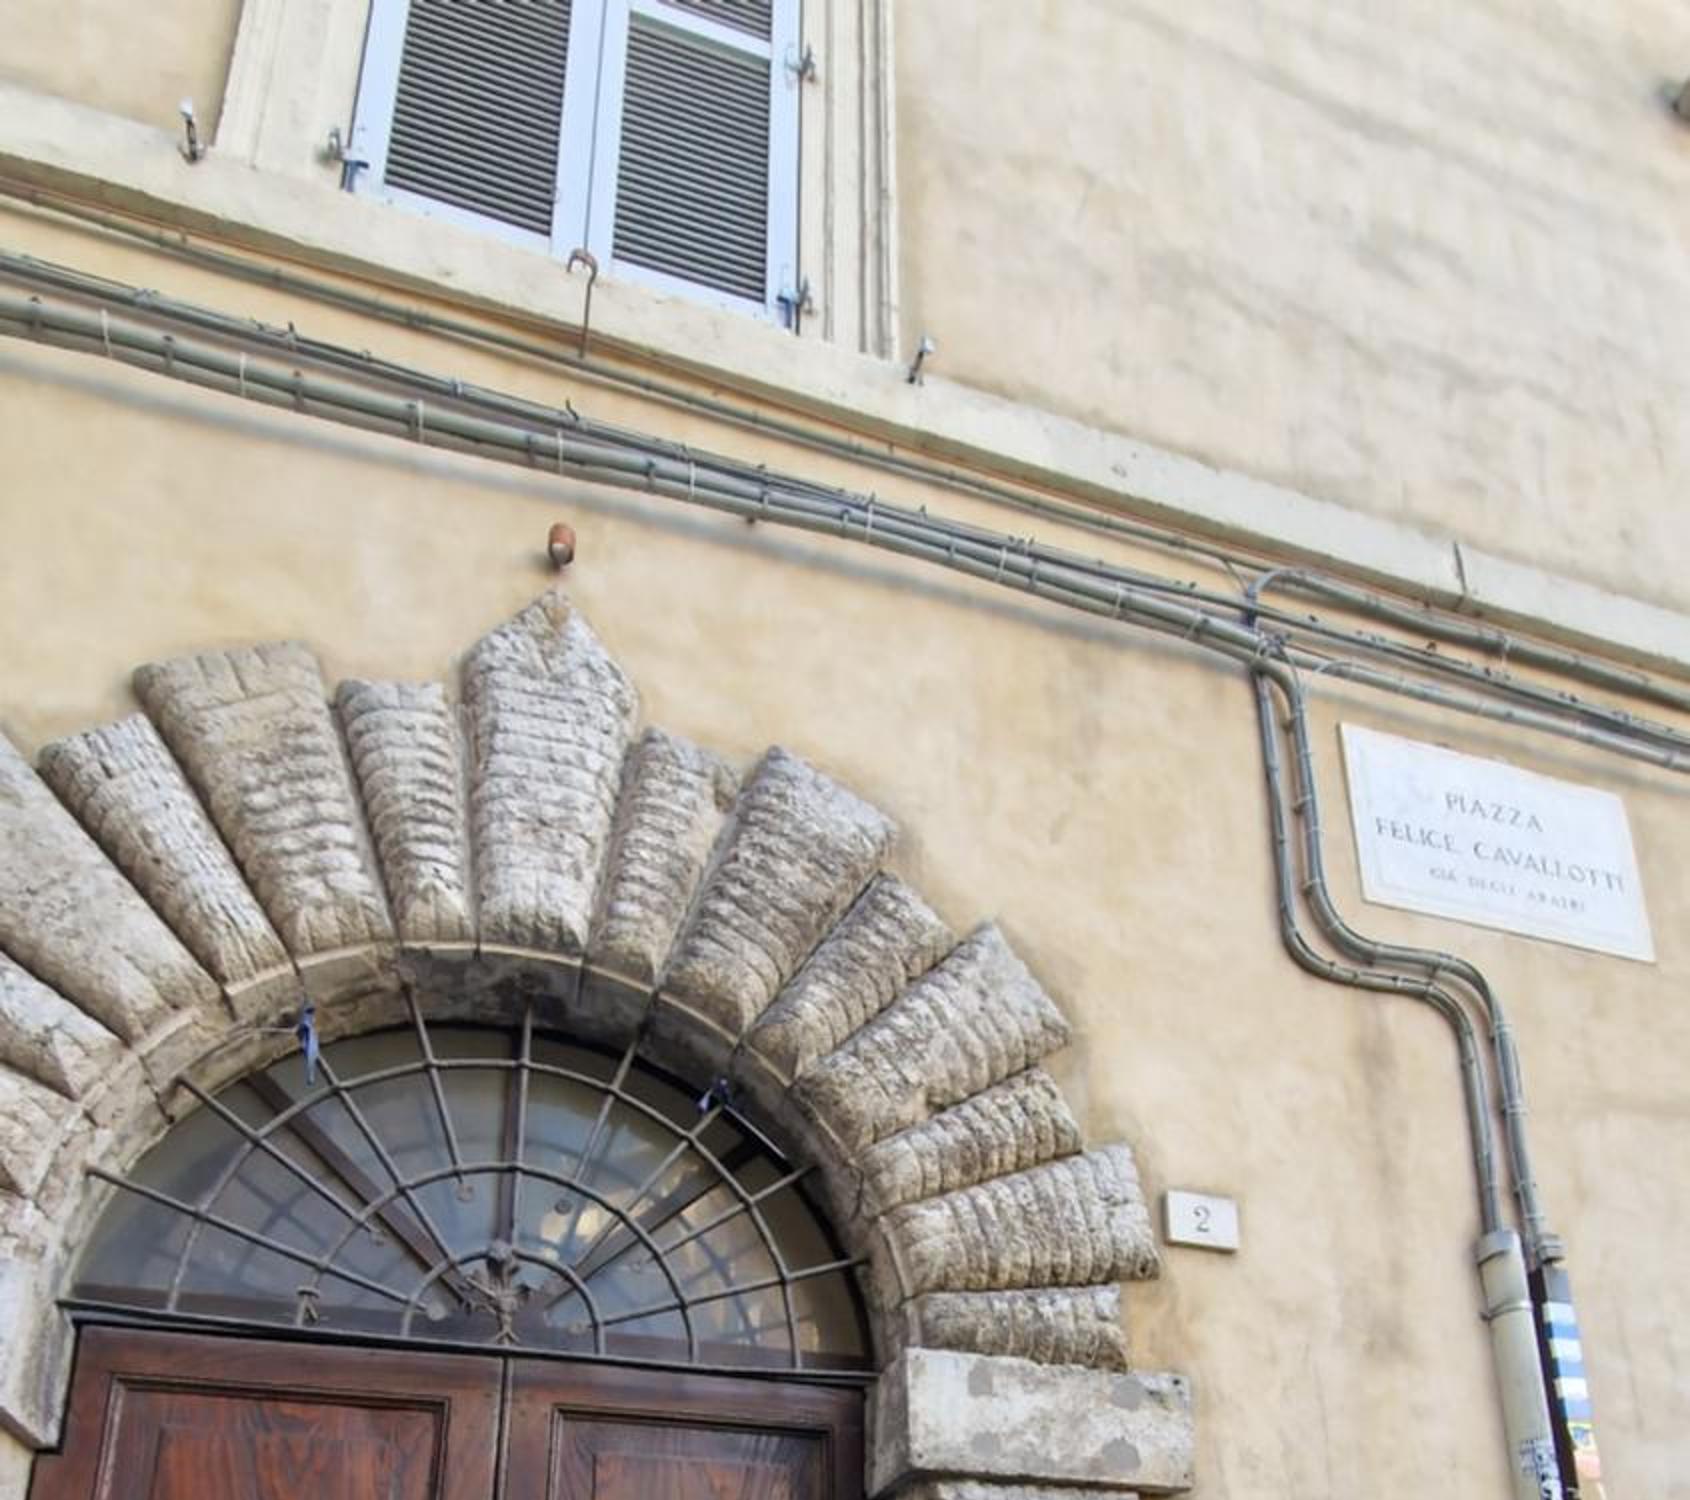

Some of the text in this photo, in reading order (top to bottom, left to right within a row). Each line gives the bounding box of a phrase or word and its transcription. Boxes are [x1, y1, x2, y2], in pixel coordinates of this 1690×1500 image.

[1445, 791, 1543, 833] PIAZZA
[1375, 817, 1625, 893] FELICE CAVALLOTTI
[1192, 1205, 1211, 1233] 2
